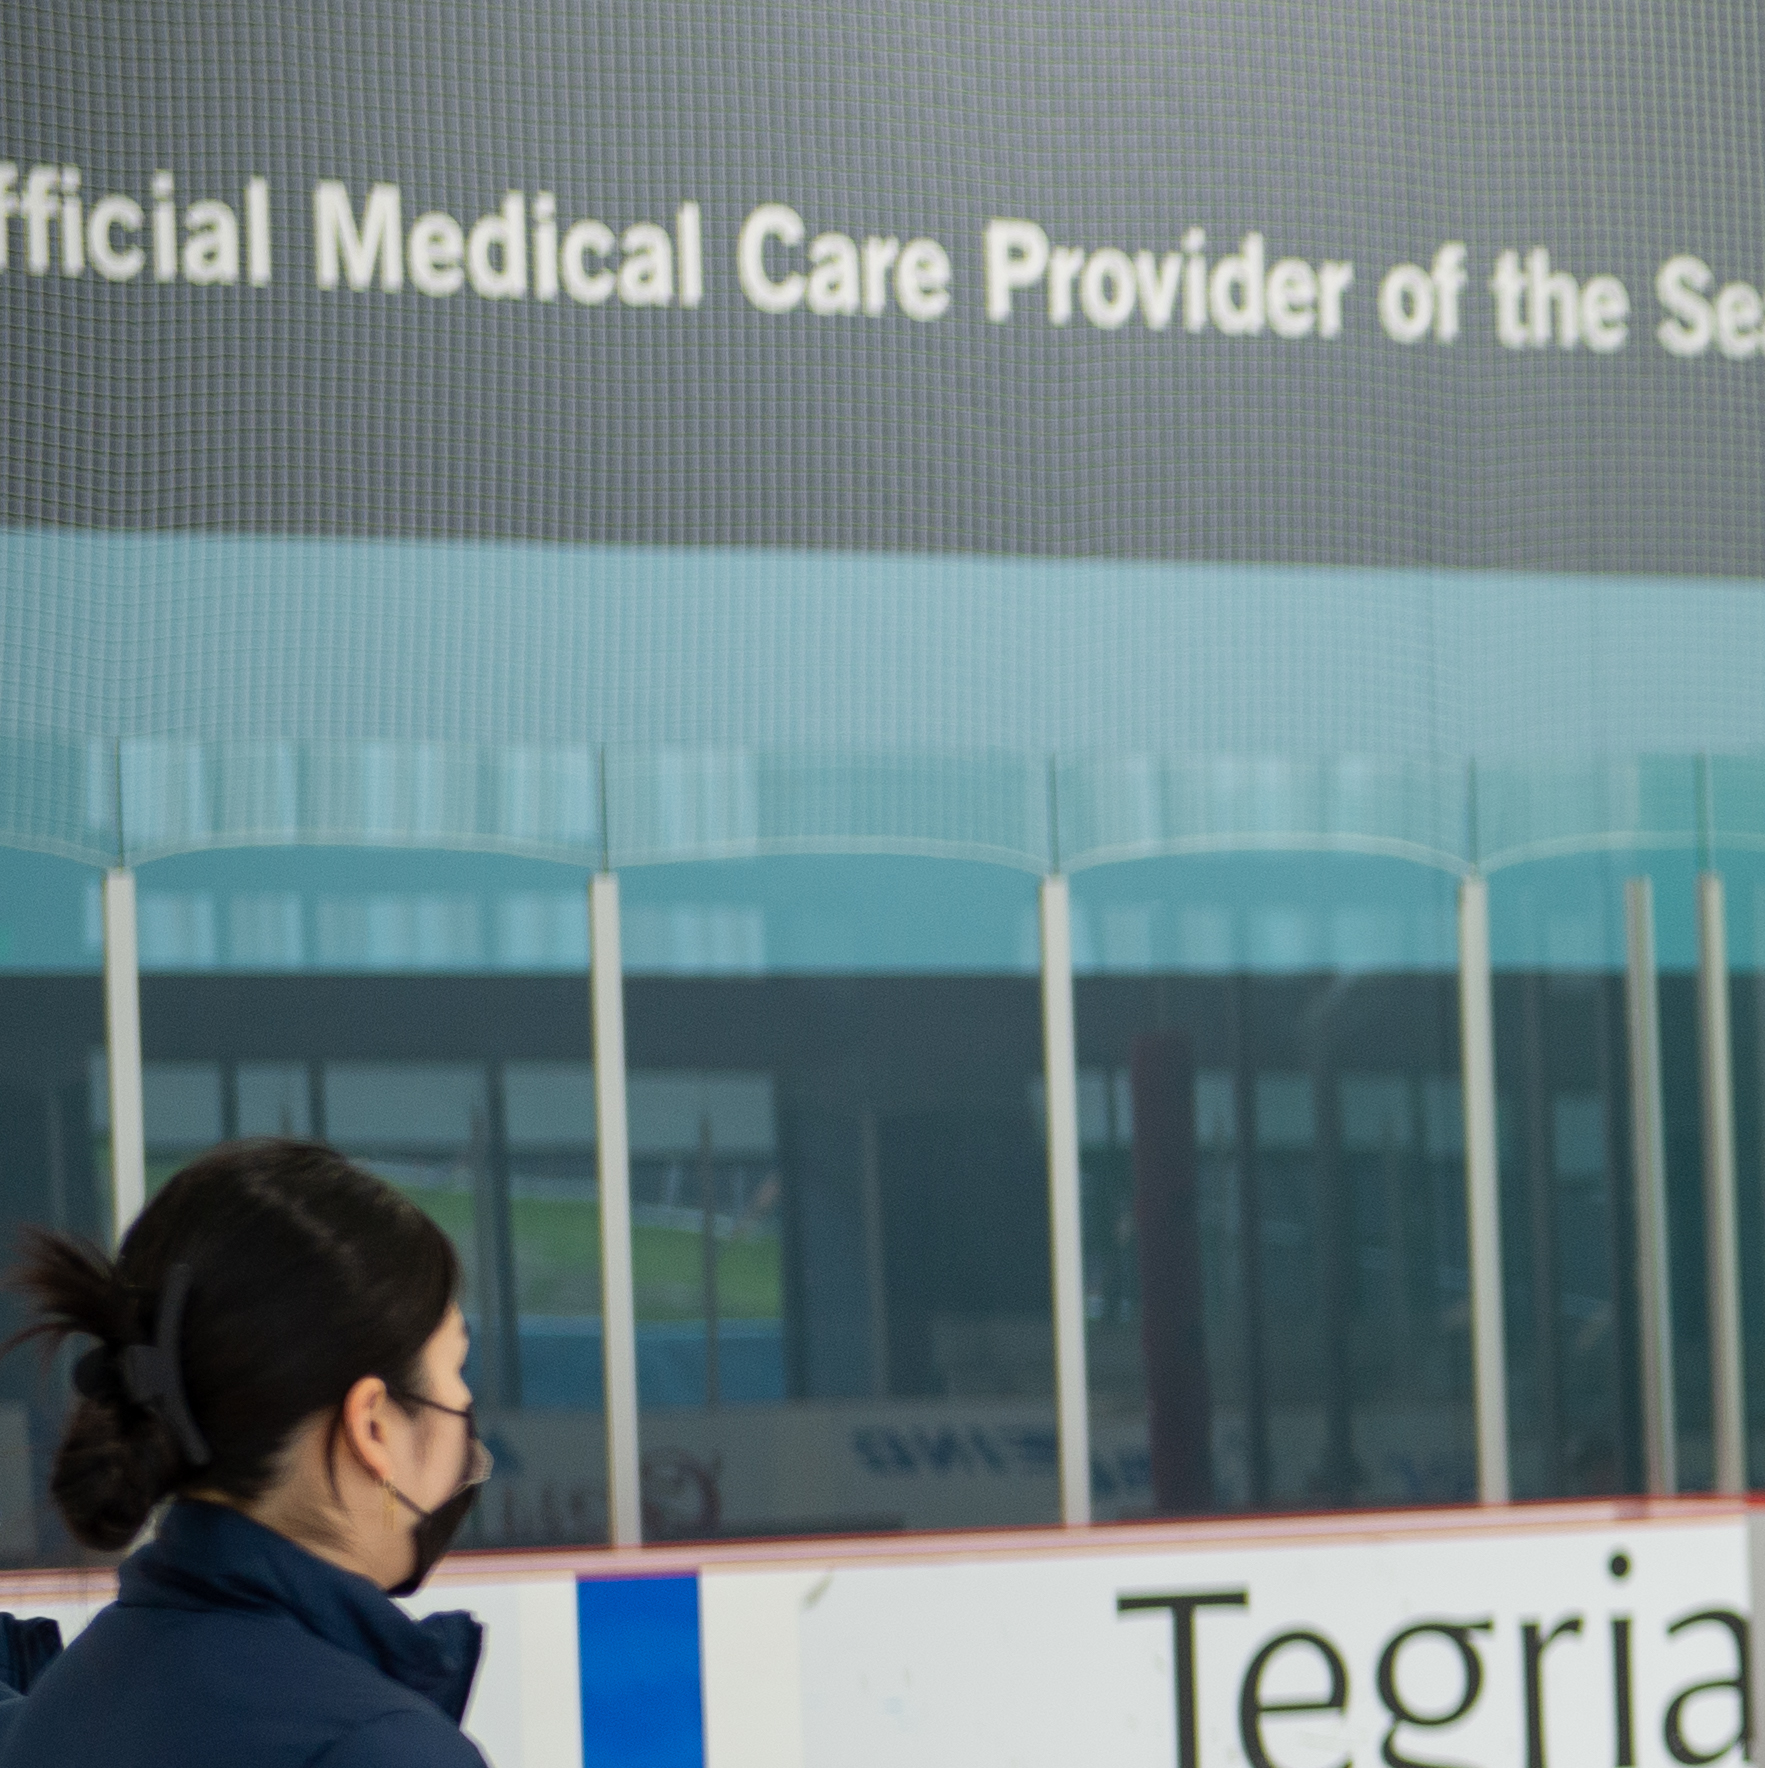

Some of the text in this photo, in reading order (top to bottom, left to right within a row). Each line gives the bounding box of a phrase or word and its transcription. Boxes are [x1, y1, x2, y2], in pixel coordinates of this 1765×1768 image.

[315, 181, 703, 308] Medical
[737, 203, 952, 322] Care
[982, 218, 1354, 341] Provider
[1378, 242, 1468, 344] of
[1490, 247, 1629, 353] the
